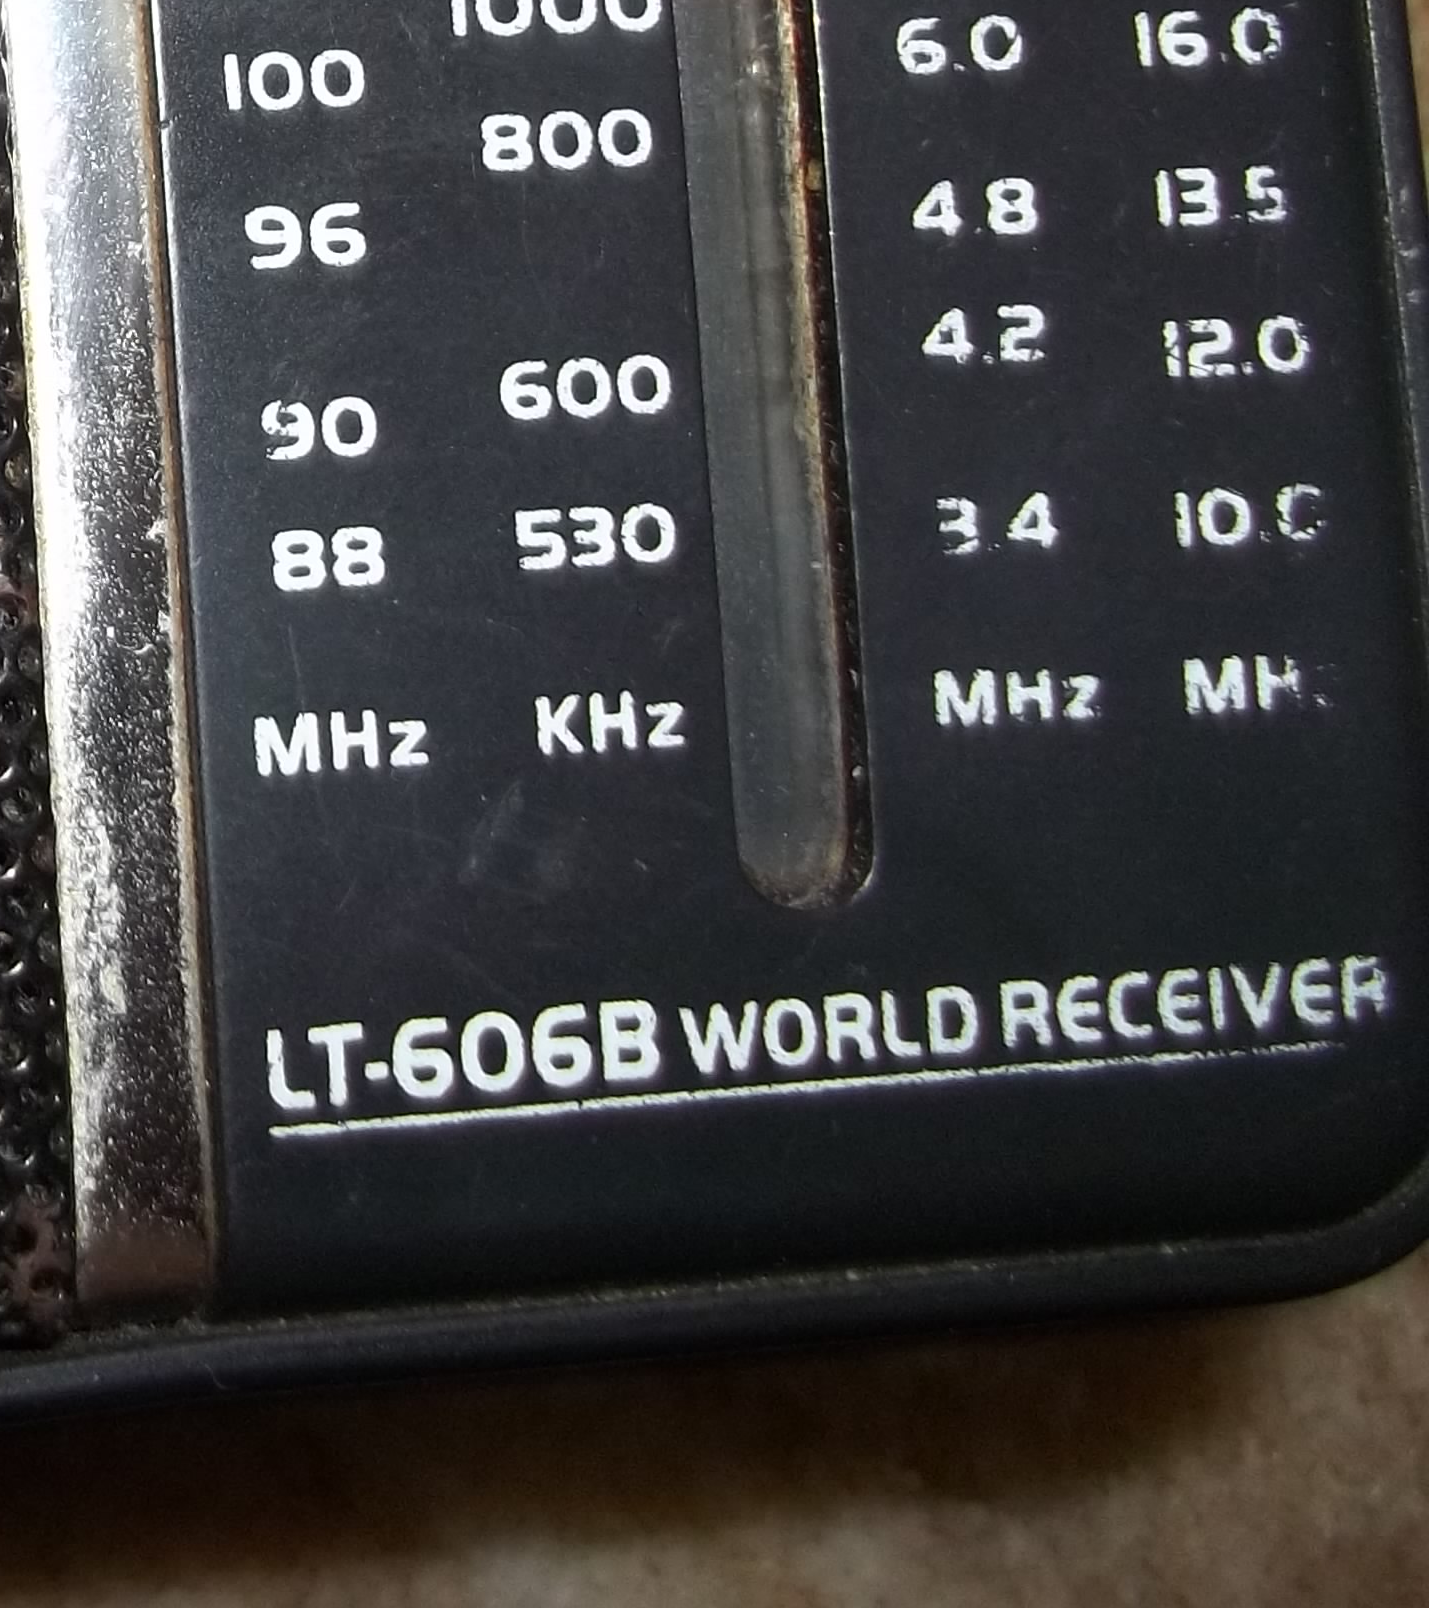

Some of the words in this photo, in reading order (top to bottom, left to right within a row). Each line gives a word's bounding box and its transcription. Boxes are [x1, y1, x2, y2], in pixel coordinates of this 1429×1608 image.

[897, 15, 1022, 74] 6.0
[224, 50, 365, 110] 100
[481, 110, 652, 171] 800
[245, 203, 366, 269] 96
[922, 305, 1045, 363] 4.2
[1163, 316, 1310, 377] 12.0
[500, 355, 671, 420] 600
[262, 397, 377, 460] 90
[272, 527, 384, 591] 88
[516, 504, 675, 570] 530
[535, 691, 684, 755] KHz
[935, 670, 1098, 725] MHz
[255, 710, 428, 776] MHz
[266, 998, 662, 1113] LT-606B
[679, 984, 980, 1073] WORLD
[1001, 956, 1389, 1045] RECEIVER
